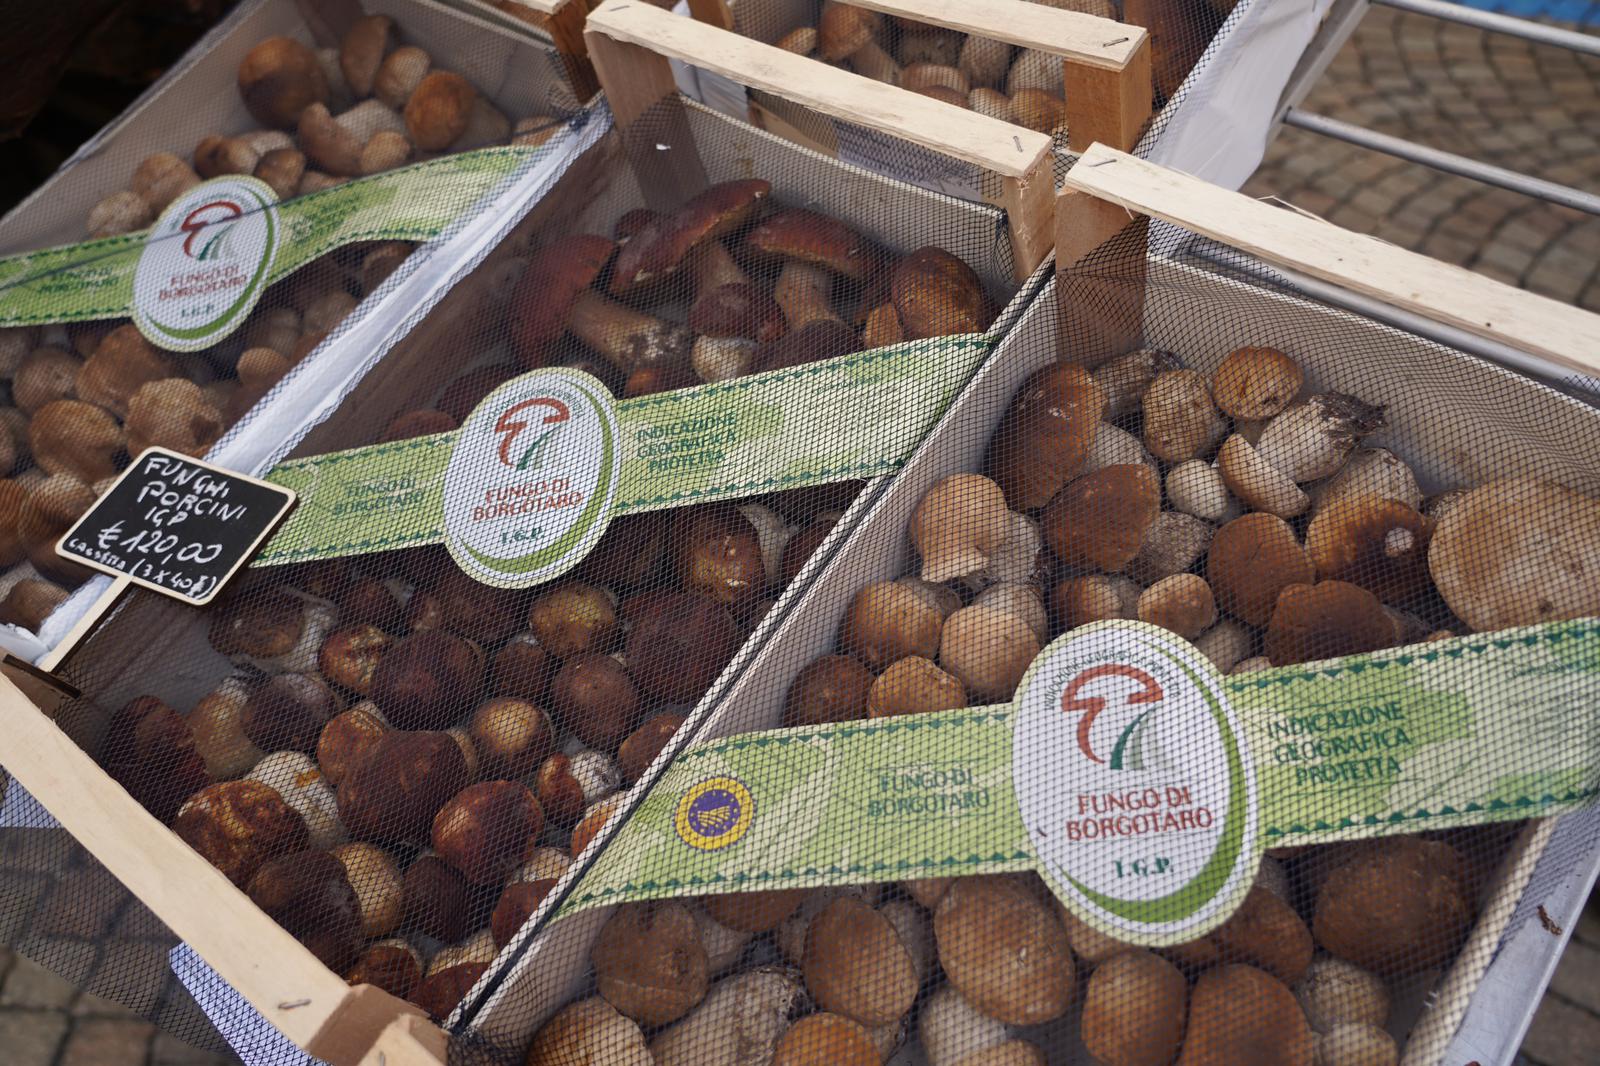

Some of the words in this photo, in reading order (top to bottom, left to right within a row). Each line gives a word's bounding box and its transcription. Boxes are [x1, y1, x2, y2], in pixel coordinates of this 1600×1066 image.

[143, 456, 230, 499] FUNGHI
[485, 480, 548, 504] FUNGO
[552, 477, 571, 493] DI
[136, 480, 248, 522] PORCINI
[144, 505, 189, 528] IGP
[472, 492, 585, 521] BORGOTARO
[97, 520, 126, 550] €
[120, 530, 224, 565] 120,00
[1267, 701, 1406, 739] INDICAZIONE
[1274, 727, 1412, 764] GEOGRAFICA
[881, 771, 948, 792] FUNGO
[951, 768, 973, 785] DI
[1296, 755, 1403, 787] PROTETTA
[868, 787, 990, 817] BORGOTARO
[1077, 789, 1161, 815] FUNGO
[1165, 786, 1192, 807] DI
[1065, 808, 1214, 841] BORGOTARO
[1114, 857, 1174, 878] I.G.P.
